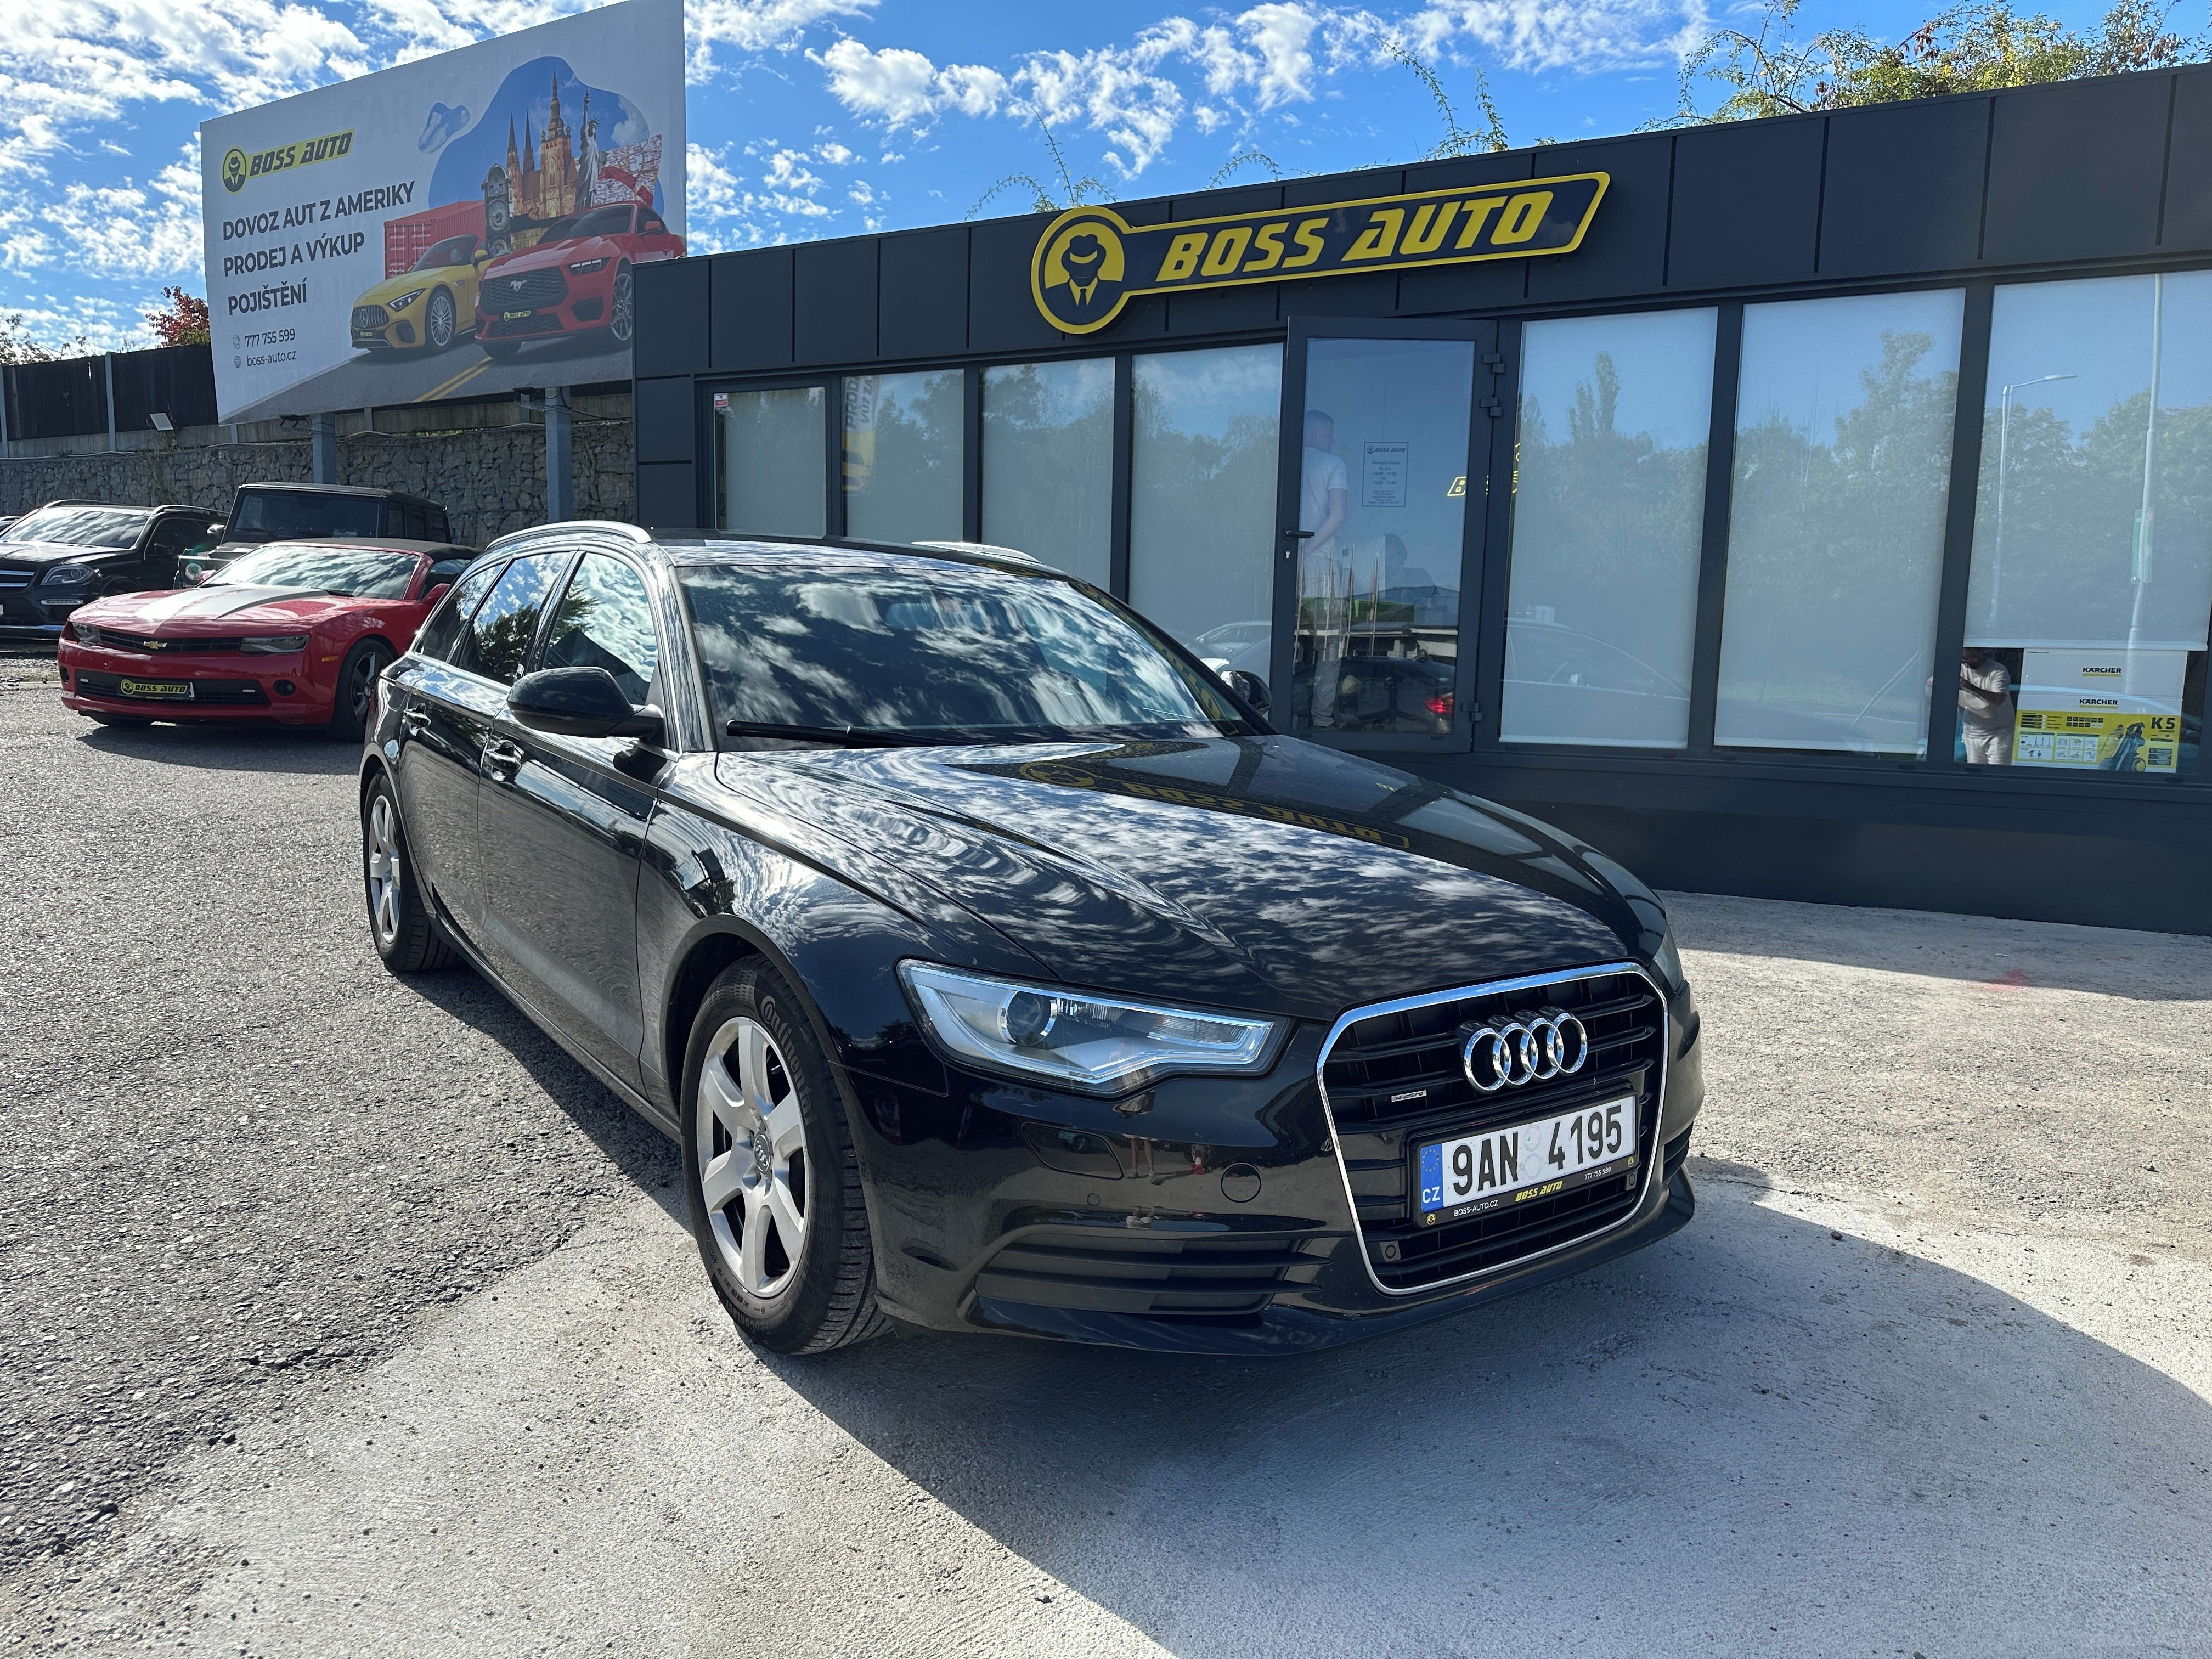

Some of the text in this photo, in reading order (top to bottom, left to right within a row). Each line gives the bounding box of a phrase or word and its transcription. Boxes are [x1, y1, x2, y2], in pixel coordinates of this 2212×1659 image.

[249, 132, 352, 177] BOSS AUTO
[223, 180, 415, 241] DOVOZ AUT Z AMERIKY
[224, 233, 365, 276] PRODEJ A VÝKUP
[1155, 190, 1554, 283] BOSS AUTO
[228, 277, 307, 315] POJIŠTĚNÍ
[245, 328, 295, 347] 777 755 599
[247, 351, 296, 366] boss-auto.cz
[845, 377, 860, 430] PROD
[2151, 717, 2175, 729] K 5
[760, 995, 818, 1125] Continental
[1396, 1092, 1423, 1100] quattro
[1453, 1105, 1622, 1195] 9AN 4195
[1422, 1186, 1440, 1204] CZ
[1454, 1199, 1498, 1217] BOSS-AUTO.CZ
[1515, 1187, 1538, 1202] BOSS
[1539, 1181, 1563, 1195] AUTO
[1584, 1172, 1593, 1180] 777
[1593, 1169, 1601, 1178] 755
